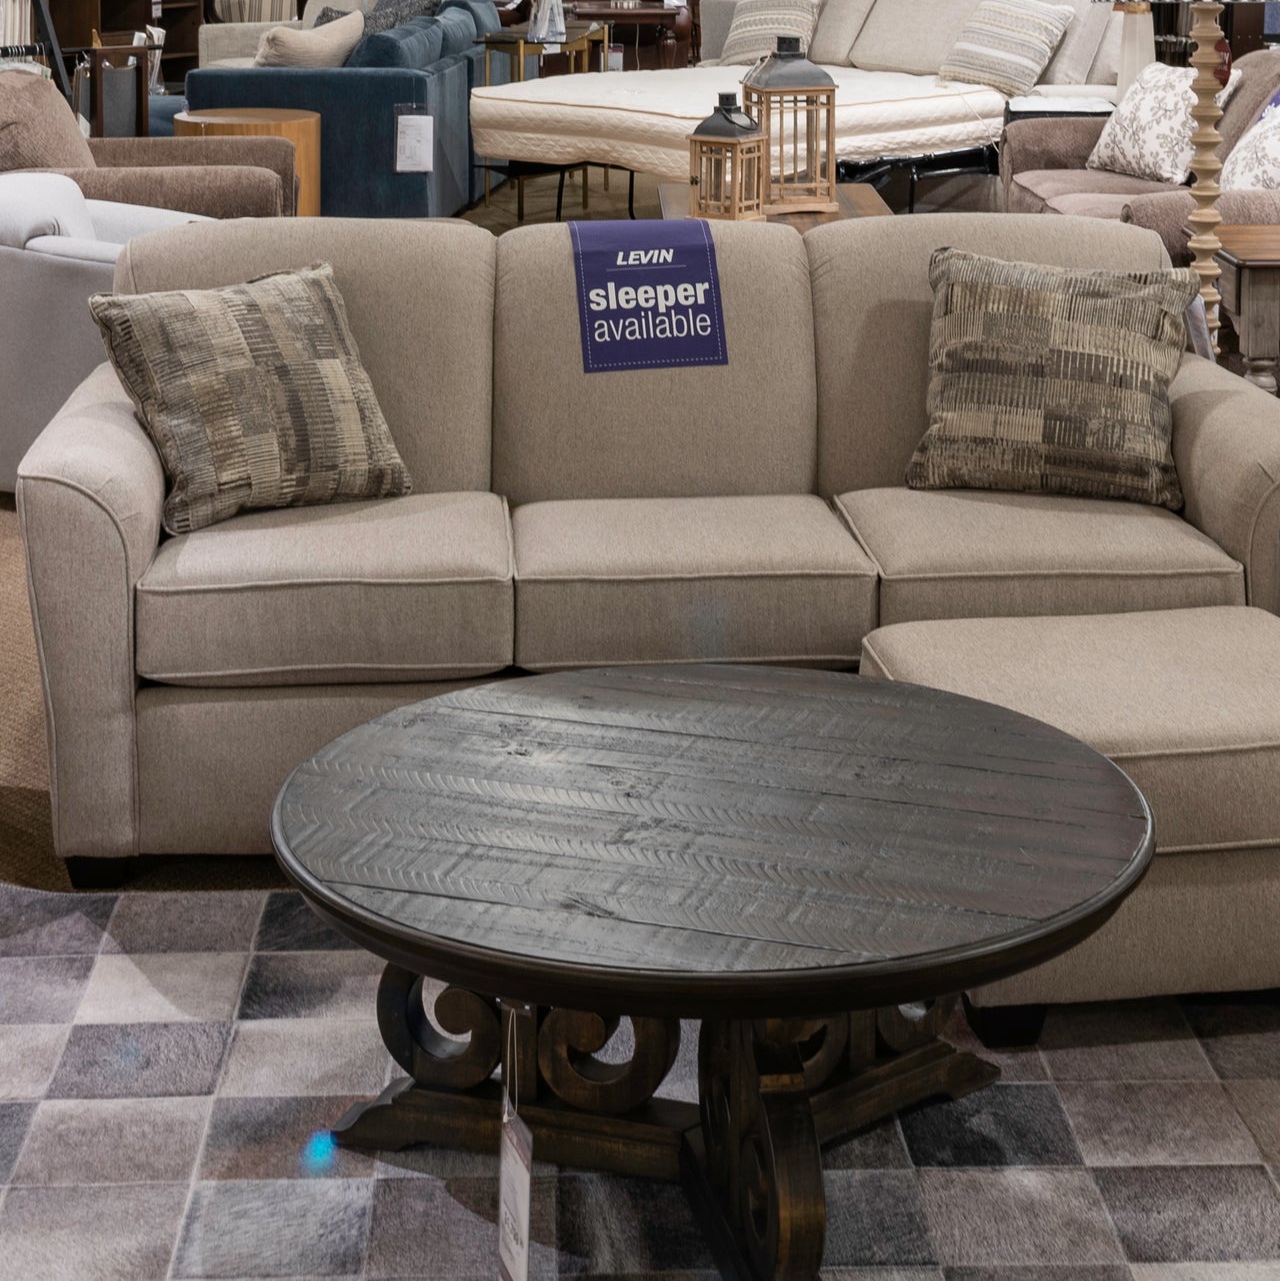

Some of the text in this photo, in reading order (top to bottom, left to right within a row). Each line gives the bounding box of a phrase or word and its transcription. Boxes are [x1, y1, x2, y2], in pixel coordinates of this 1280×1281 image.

[616, 248, 674, 266] LEVIN
[589, 281, 710, 313] sleeper
[594, 308, 712, 343] available
